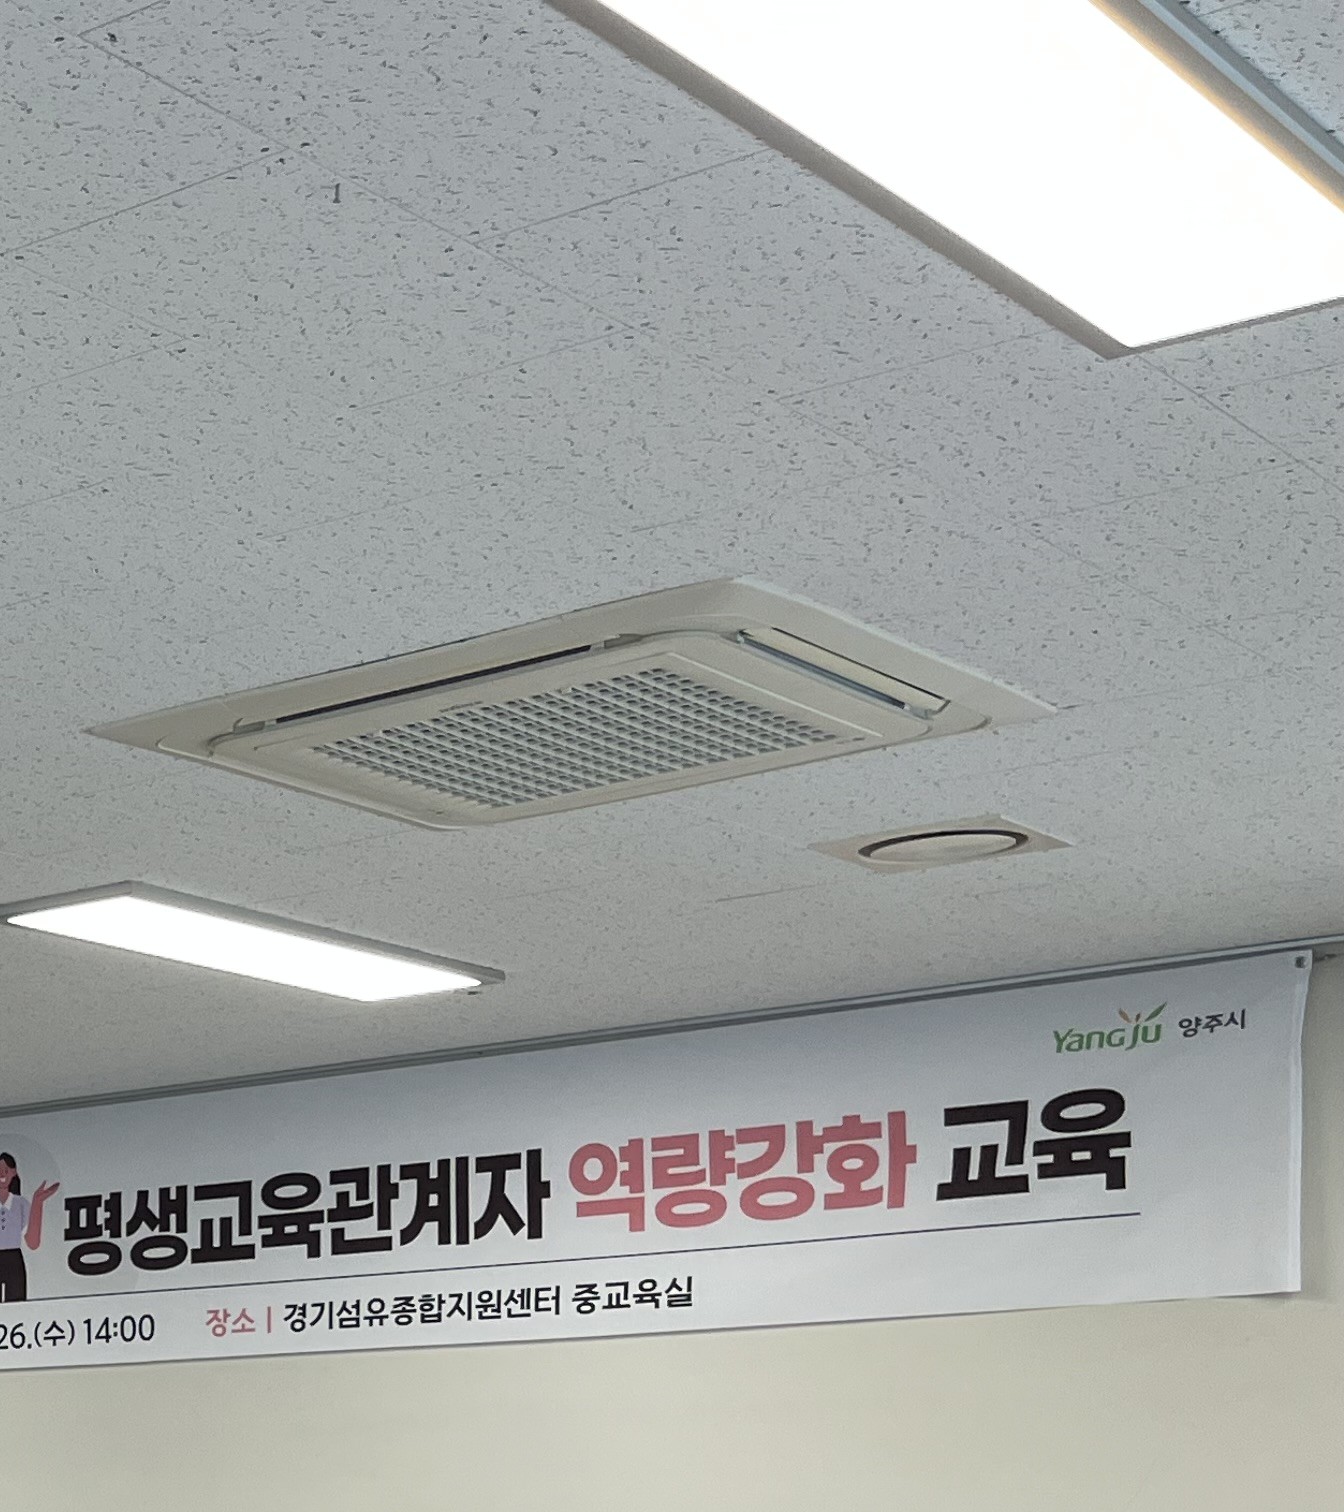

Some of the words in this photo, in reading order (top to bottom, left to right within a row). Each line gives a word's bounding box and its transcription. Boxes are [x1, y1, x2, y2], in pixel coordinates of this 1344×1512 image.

[1178, 1008, 1246, 1038] 양주시
[64, 1148, 551, 1276] 평생교육관계자
[568, 1110, 917, 1232] 역량강화
[936, 1088, 1132, 1201] 교육
[83, 1314, 156, 1345] 14:00
[206, 1307, 256, 1337] 장소
[283, 1285, 561, 1333] 경기섬유종합지원센터
[572, 1276, 694, 1316] 중교육실
